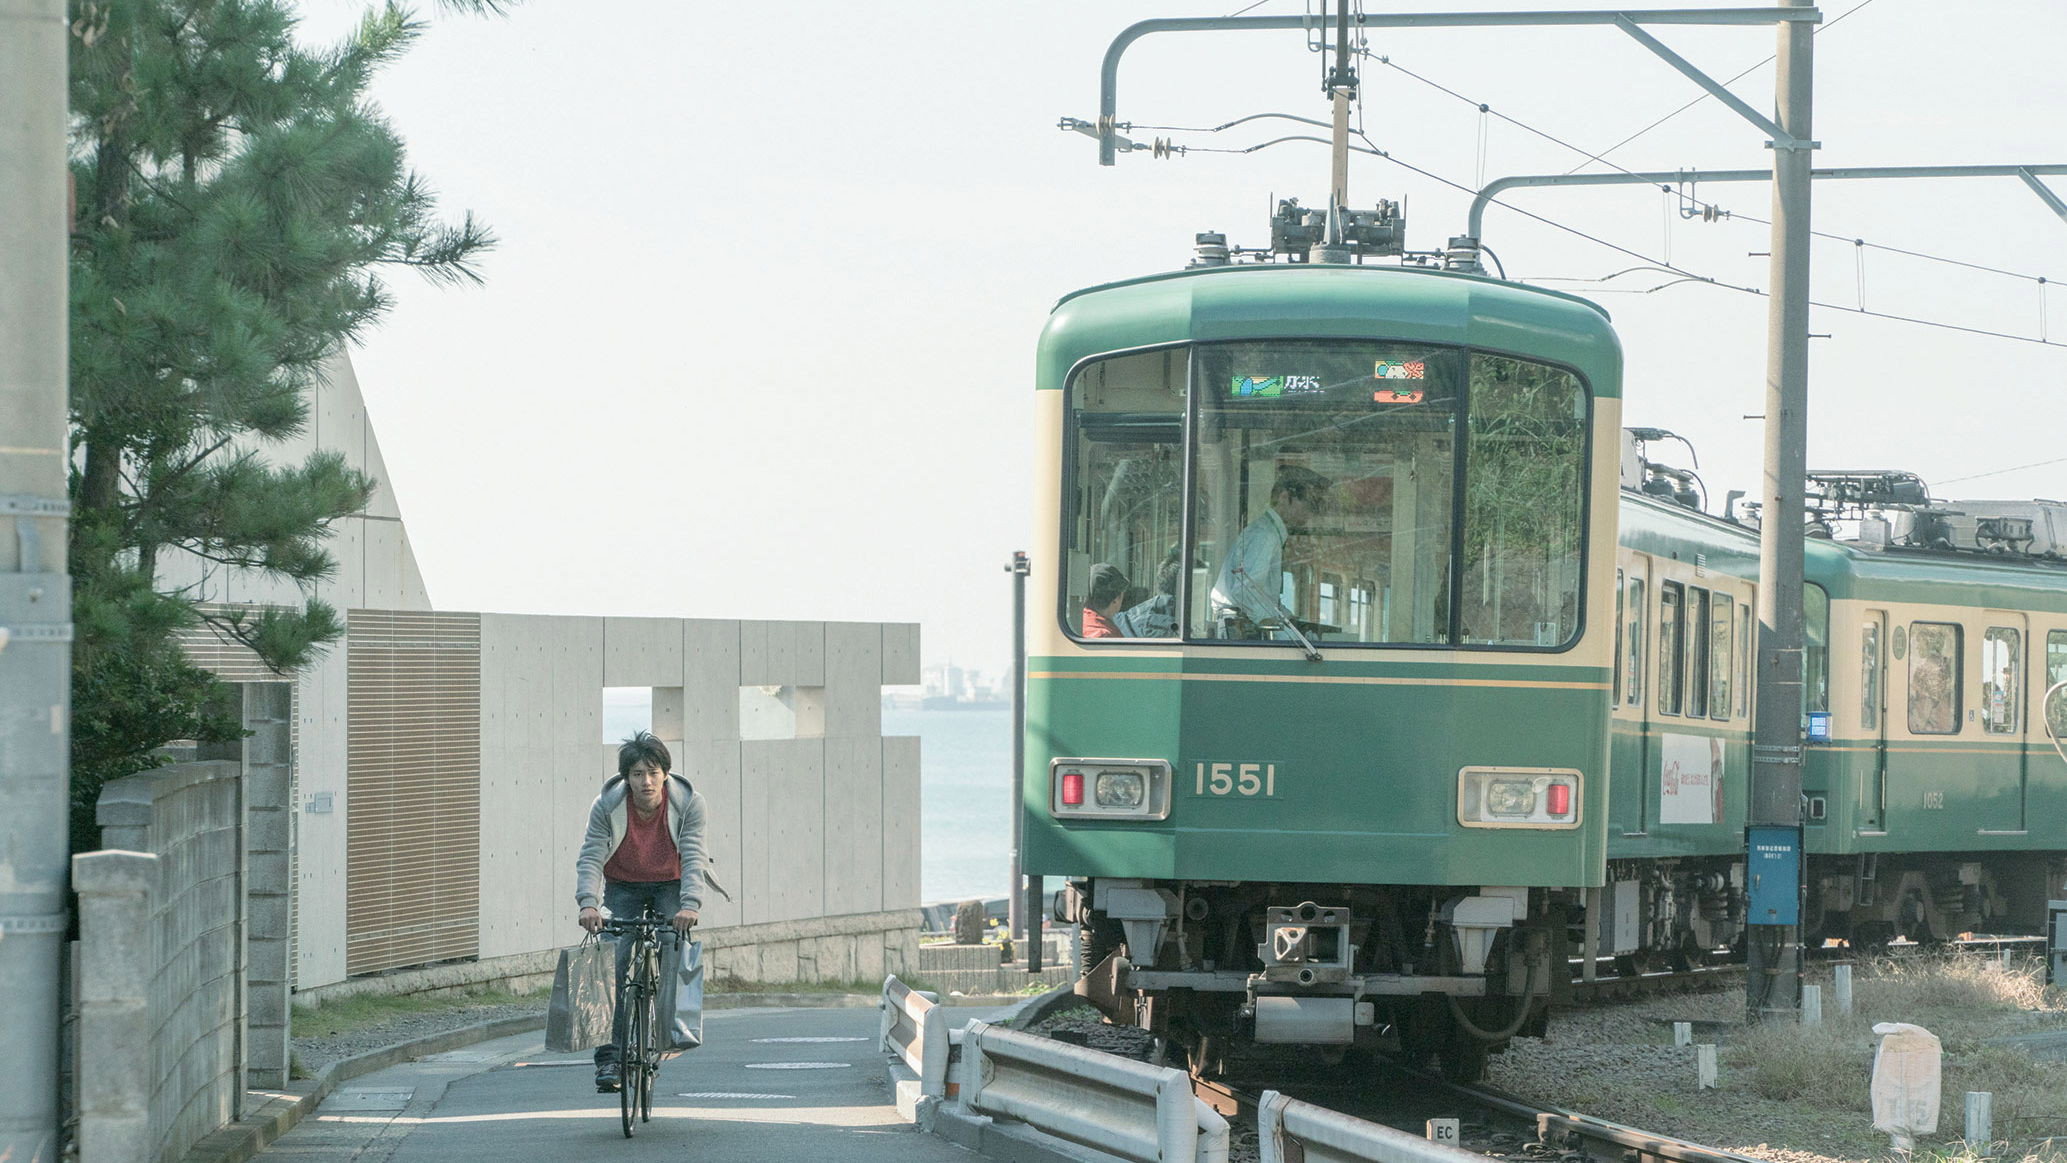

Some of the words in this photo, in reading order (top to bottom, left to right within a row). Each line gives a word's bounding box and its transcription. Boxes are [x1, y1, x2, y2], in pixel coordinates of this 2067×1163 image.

[1196, 763, 1275, 796] 1551
[1923, 792, 1944, 809] 1052
[1437, 1126, 1453, 1140] EC
